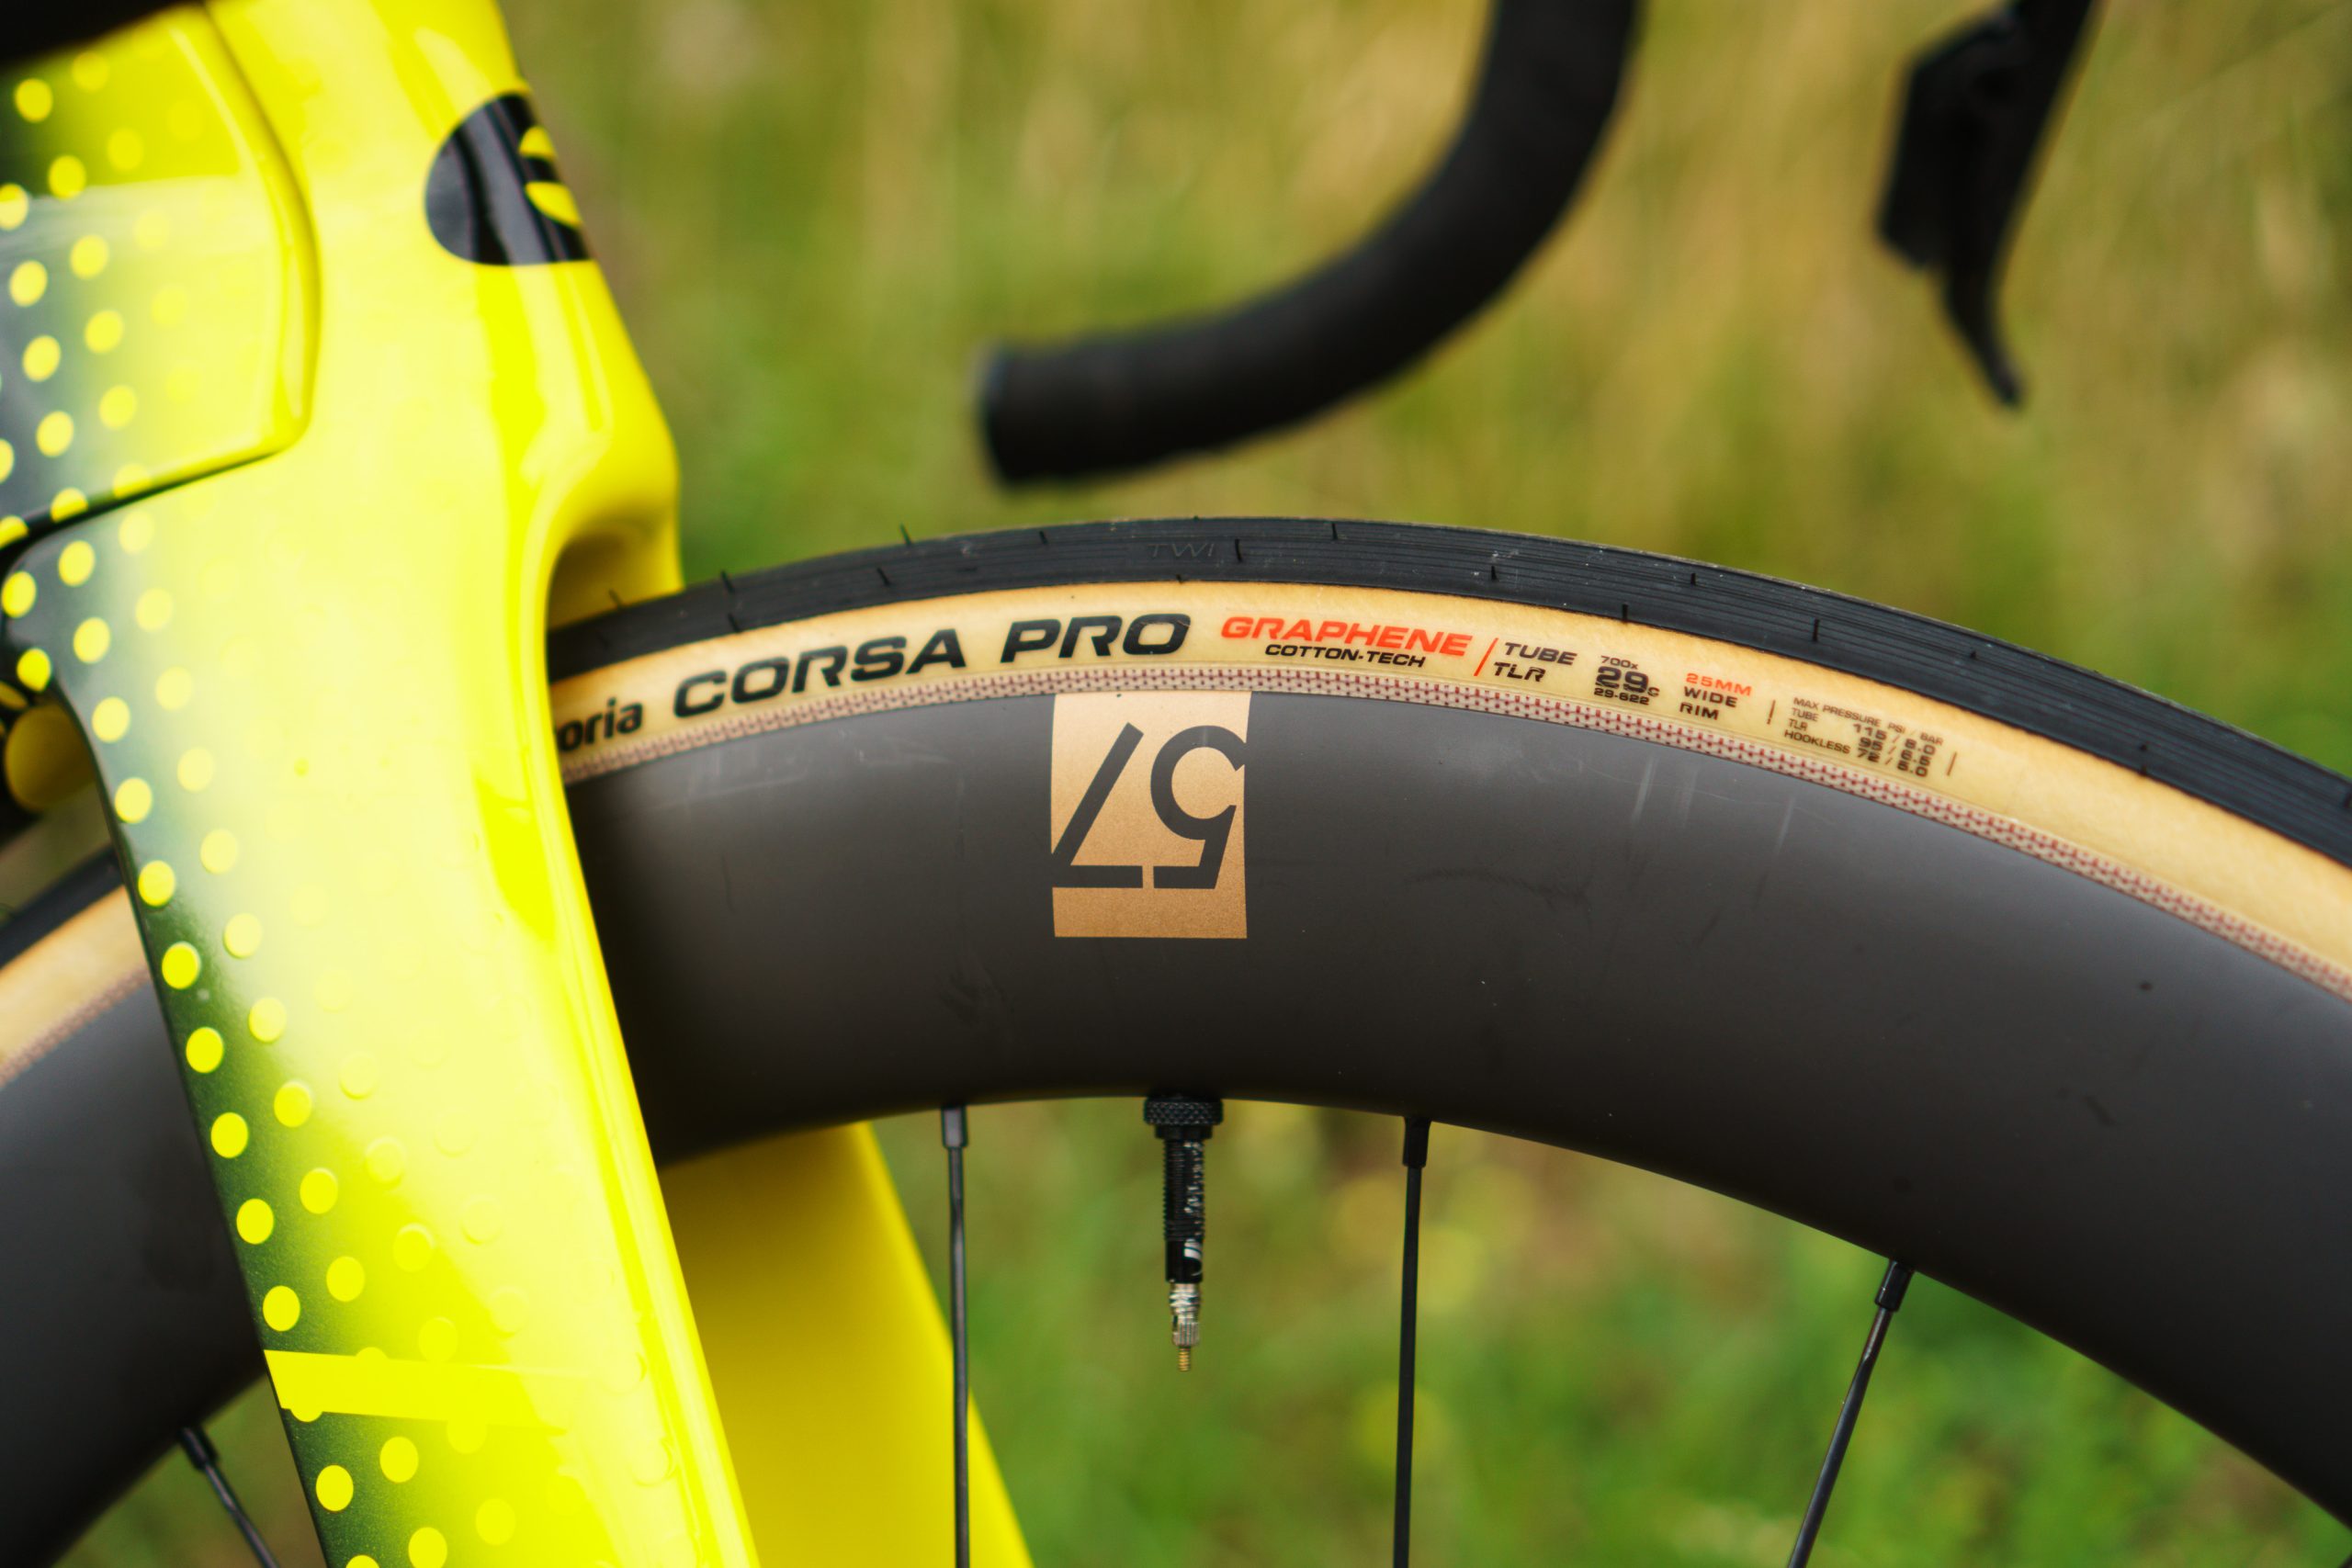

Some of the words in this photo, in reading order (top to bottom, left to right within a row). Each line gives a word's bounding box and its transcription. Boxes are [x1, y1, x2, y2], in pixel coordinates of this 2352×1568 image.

[1220, 616, 1474, 657] GRAPHENE
[1264, 644, 1427, 669] COTTON-TECH
[1503, 642, 1578, 666] TUBE
[557, 697, 643, 752] oria
[672, 628, 967, 719] CORSA
[1001, 613, 1192, 664] PRO
[1493, 661, 1546, 682] TLR
[1685, 672, 1753, 696] 25MM
[1593, 687, 1649, 705] 29-622
[1683, 686, 1738, 708] WIDE
[1679, 702, 1719, 720] RIM
[1792, 697, 1819, 710] MAX
[1822, 705, 1882, 728] PRESSURE
[1887, 722, 1906, 734] PSI
[1920, 731, 1944, 746] BAR
[1792, 707, 1819, 722] TUBE
[1853, 723, 1887, 740] 115
[1784, 729, 1851, 754] HOOKLESS
[1788, 718, 1808, 731] TLR
[1858, 737, 1883, 751] 95
[1052, 722, 1245, 889] 57
